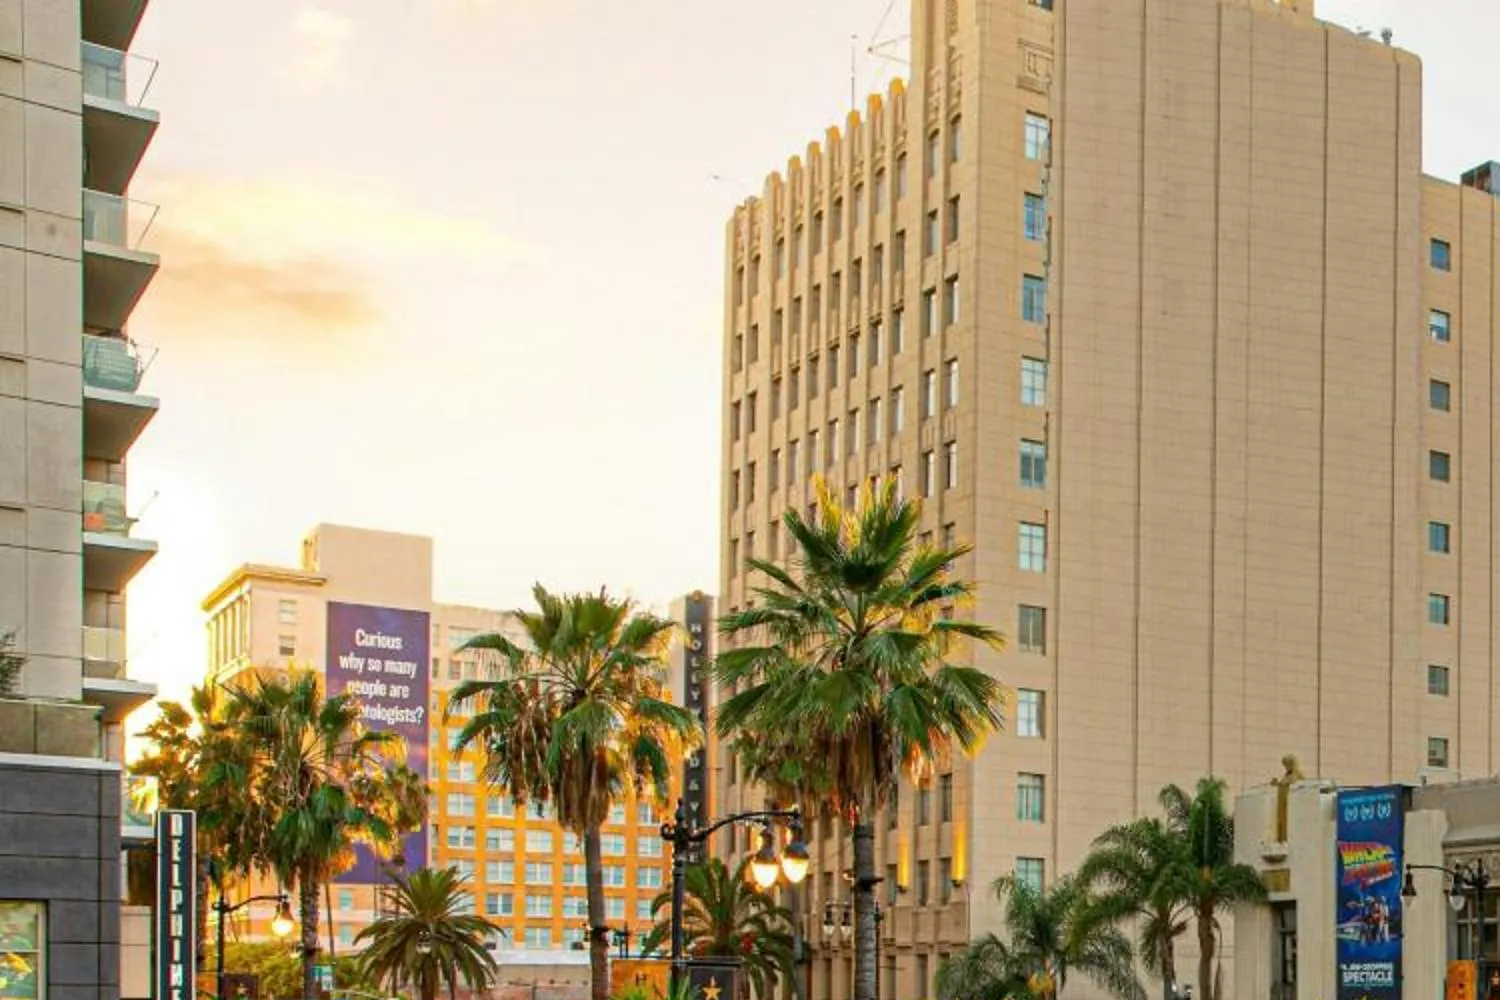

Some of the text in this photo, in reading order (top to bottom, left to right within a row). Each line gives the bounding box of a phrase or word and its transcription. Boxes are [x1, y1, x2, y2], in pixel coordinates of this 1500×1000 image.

[355, 628, 403, 650] Curious
[339, 651, 417, 680] why so many
[389, 684, 409, 699] are
[690, 622, 702, 768] HOLLYWD
